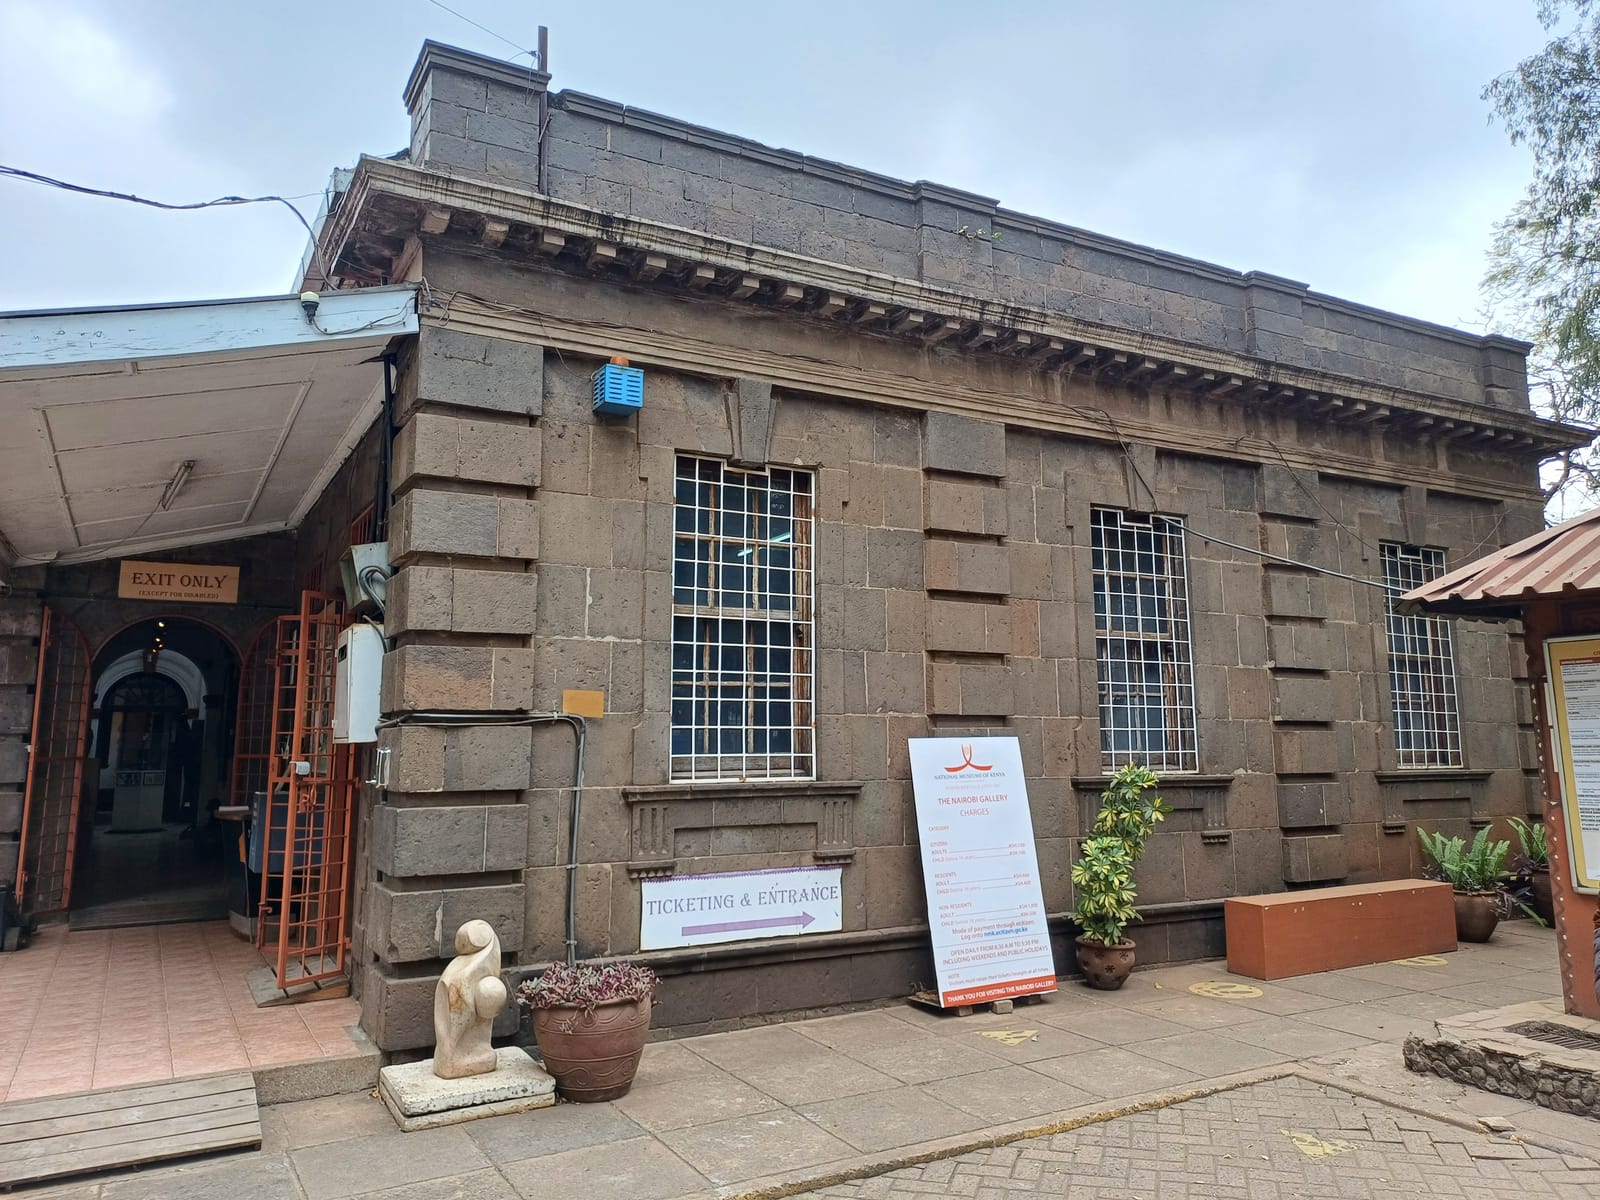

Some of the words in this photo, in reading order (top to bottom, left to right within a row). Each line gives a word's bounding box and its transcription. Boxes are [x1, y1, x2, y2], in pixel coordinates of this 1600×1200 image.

[131, 572, 176, 586] EXIT
[180, 574, 229, 589] ONLY
[938, 797, 950, 805] THE
[951, 796, 978, 805] NAIROBI
[979, 794, 1008, 803] GALLERY
[960, 808, 989, 817] CHARGES
[646, 894, 734, 915] TICKETING
[740, 893, 752, 907] &
[758, 886, 838, 905] ENTRANCE
[974, 925, 995, 934] payment
[996, 922, 1014, 930] through
[943, 956, 971, 966] INCLUDING
[972, 954, 996, 962] WEEKENDS
[1008, 948, 1024, 956] PUBLIC
[1025, 946, 1048, 954] HOLIDAYS
[986, 988, 1006, 997] VISITING
[1016, 984, 1034, 992] NAIROBI
[1034, 980, 1054, 989] GALLERY
